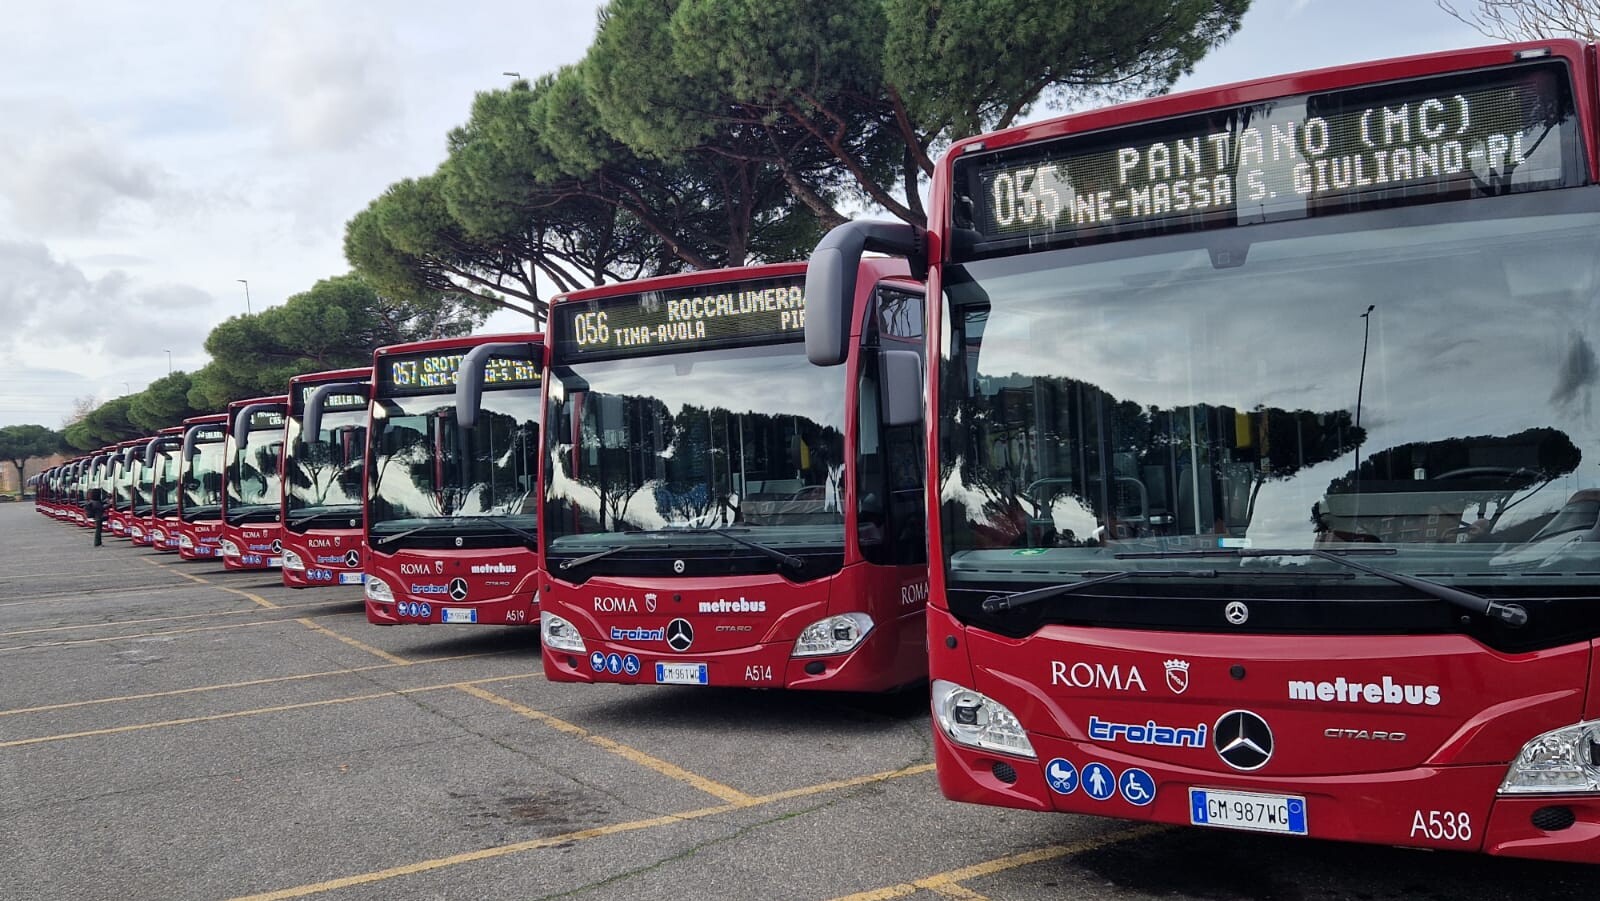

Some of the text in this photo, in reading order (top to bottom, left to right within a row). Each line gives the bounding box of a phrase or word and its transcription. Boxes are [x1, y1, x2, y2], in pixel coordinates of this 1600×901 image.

[1117, 93, 1471, 185] PANTANO (MC)
[992, 165, 1060, 226] 055
[667, 285, 805, 322] ROCCALUMERA
[574, 311, 609, 345] 056
[614, 321, 706, 346] TINA-AVOLA
[392, 361, 417, 385] 057
[423, 354, 465, 373] GROTT
[308, 539, 331, 548] ROMA
[400, 563, 431, 575] ROMA
[471, 562, 517, 574] metrebus
[594, 596, 638, 612] ROMA
[698, 596, 767, 613] metrebus
[901, 581, 929, 605] ROMA
[505, 609, 525, 622] A519
[610, 626, 665, 641] troiani
[744, 664, 773, 682] A514
[1051, 660, 1148, 692] ROMA
[1288, 676, 1441, 706] metrebus
[1088, 715, 1208, 748] troiani
[1324, 728, 1407, 742] CITARO
[1410, 810, 1472, 841] A538
